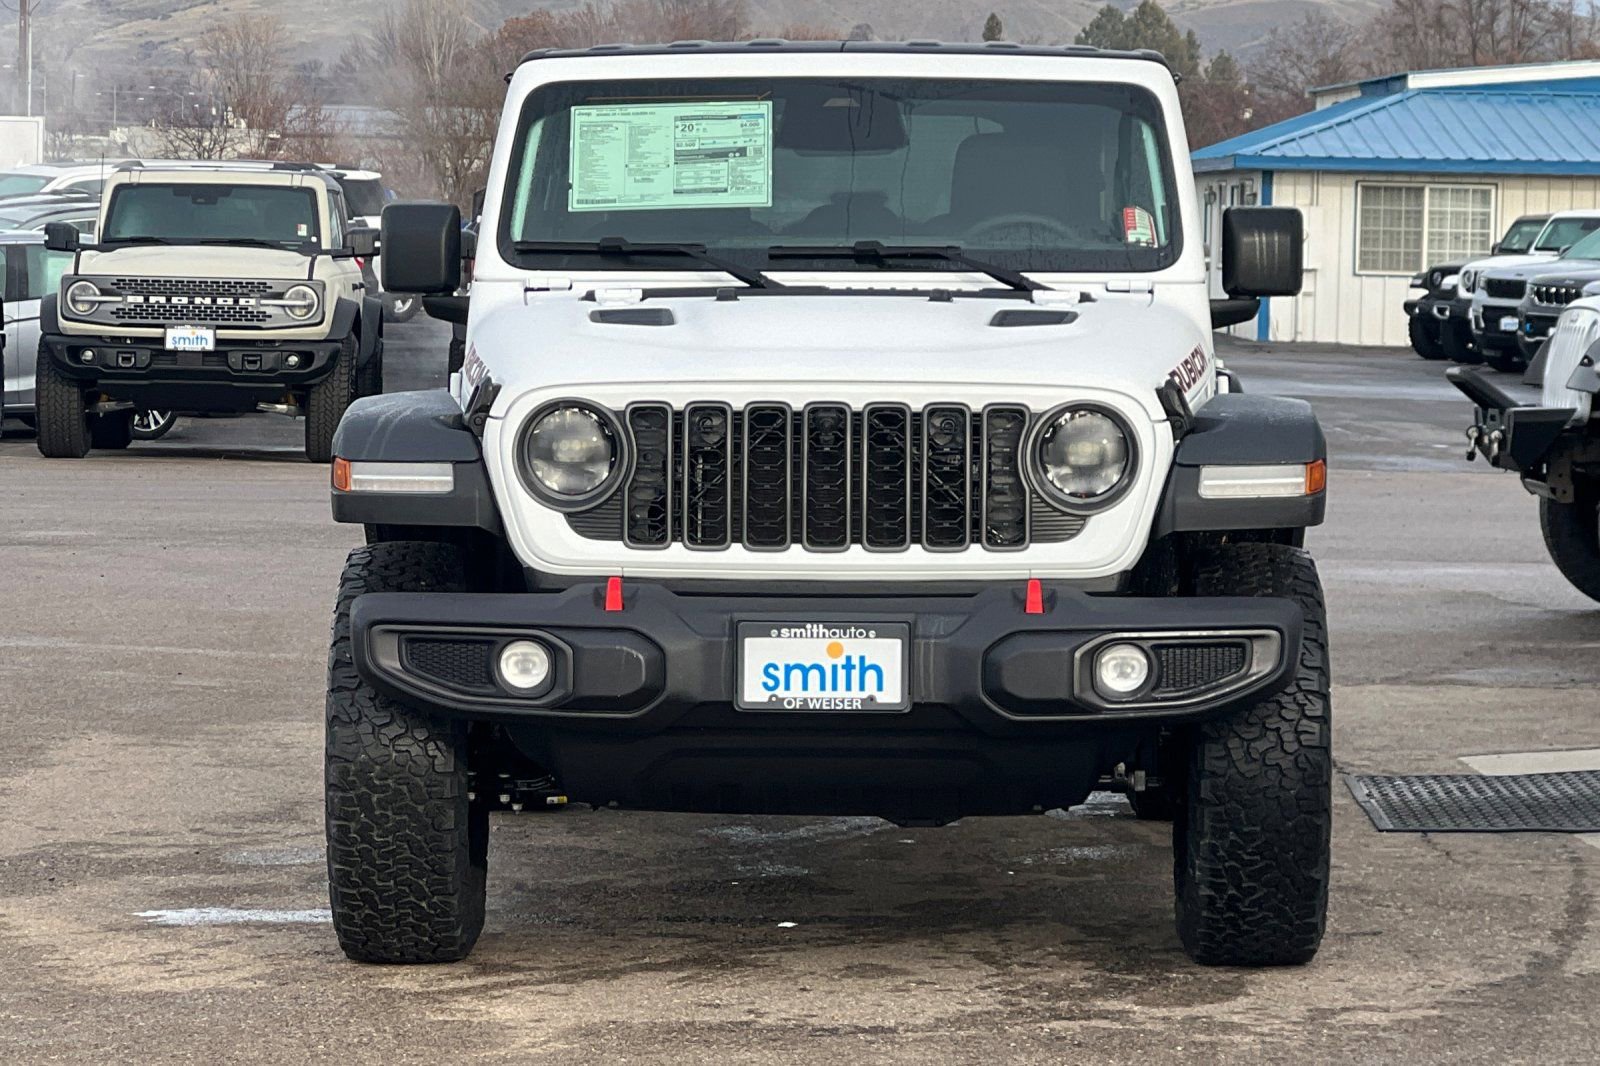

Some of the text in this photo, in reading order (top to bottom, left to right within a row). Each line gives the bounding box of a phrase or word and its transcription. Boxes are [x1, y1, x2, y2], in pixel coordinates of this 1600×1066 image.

[681, 123, 694, 132] 20
[127, 296, 256, 305] BRONCO
[171, 331, 208, 346] smith
[1168, 343, 1208, 393] RUBICON
[780, 623, 866, 639] smithauto
[761, 641, 884, 692] smith
[783, 698, 862, 709] OF WEISER
